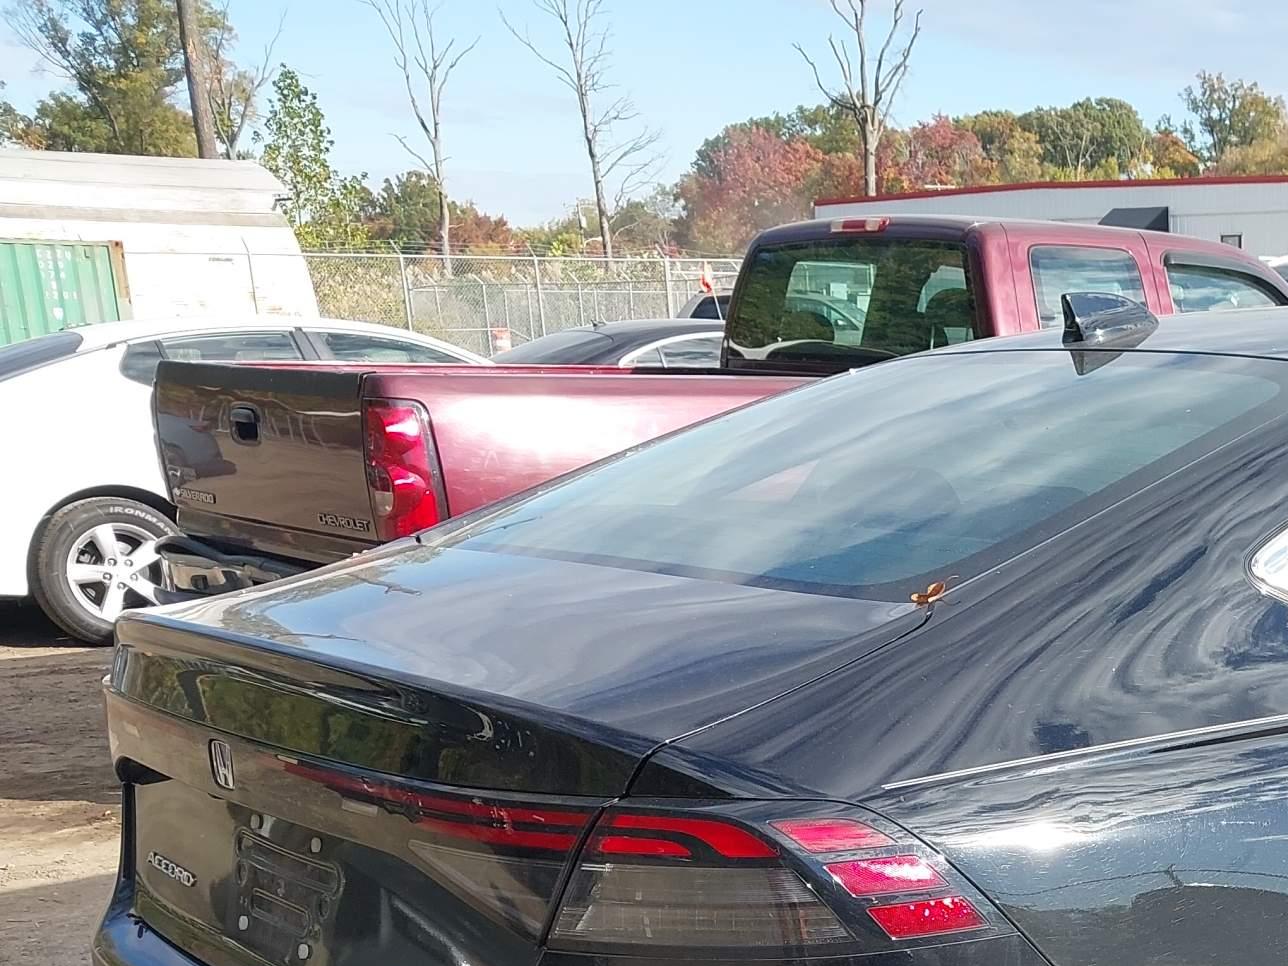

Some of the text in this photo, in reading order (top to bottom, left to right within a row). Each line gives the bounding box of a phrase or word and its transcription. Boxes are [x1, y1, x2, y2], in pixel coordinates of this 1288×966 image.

[180, 488, 215, 503] SILVERADO
[318, 513, 370, 532] CHEVROLET
[146, 851, 196, 887] ACCORD
